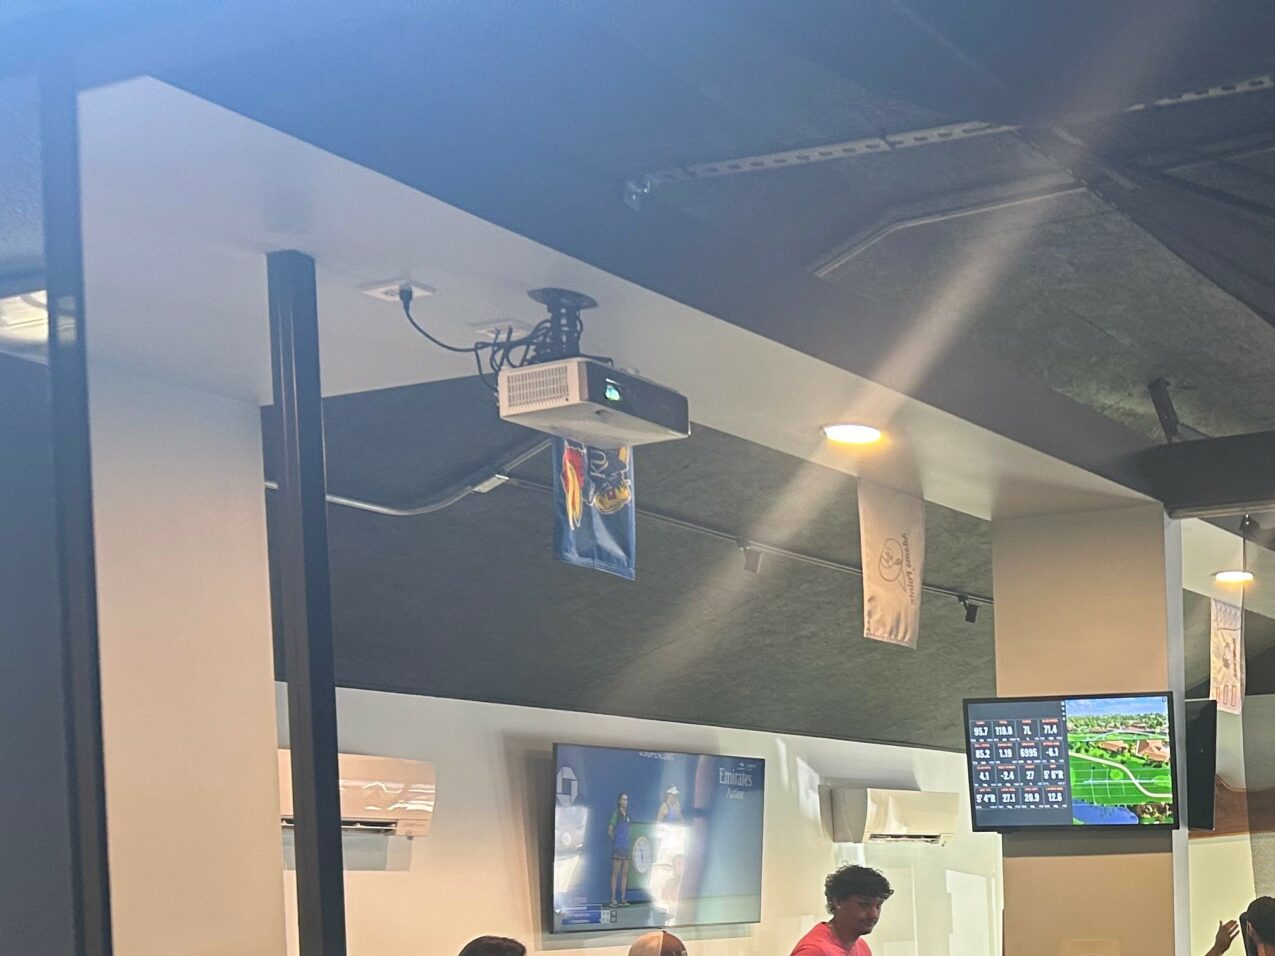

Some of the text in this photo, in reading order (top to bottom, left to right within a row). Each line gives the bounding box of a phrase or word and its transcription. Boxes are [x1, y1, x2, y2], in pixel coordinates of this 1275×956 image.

[974, 727, 988, 736] 95.7
[1044, 725, 1057, 734] 71.4
[976, 749, 990, 758] 85.2
[999, 748, 1012, 757] 1.19
[719, 767, 753, 787] Emirates
[980, 772, 989, 780] 4.1
[1000, 771, 1015, 780] -2.4
[1026, 771, 1034, 779] 27
[726, 787, 745, 800] Airline
[1003, 794, 1015, 802] 27.1
